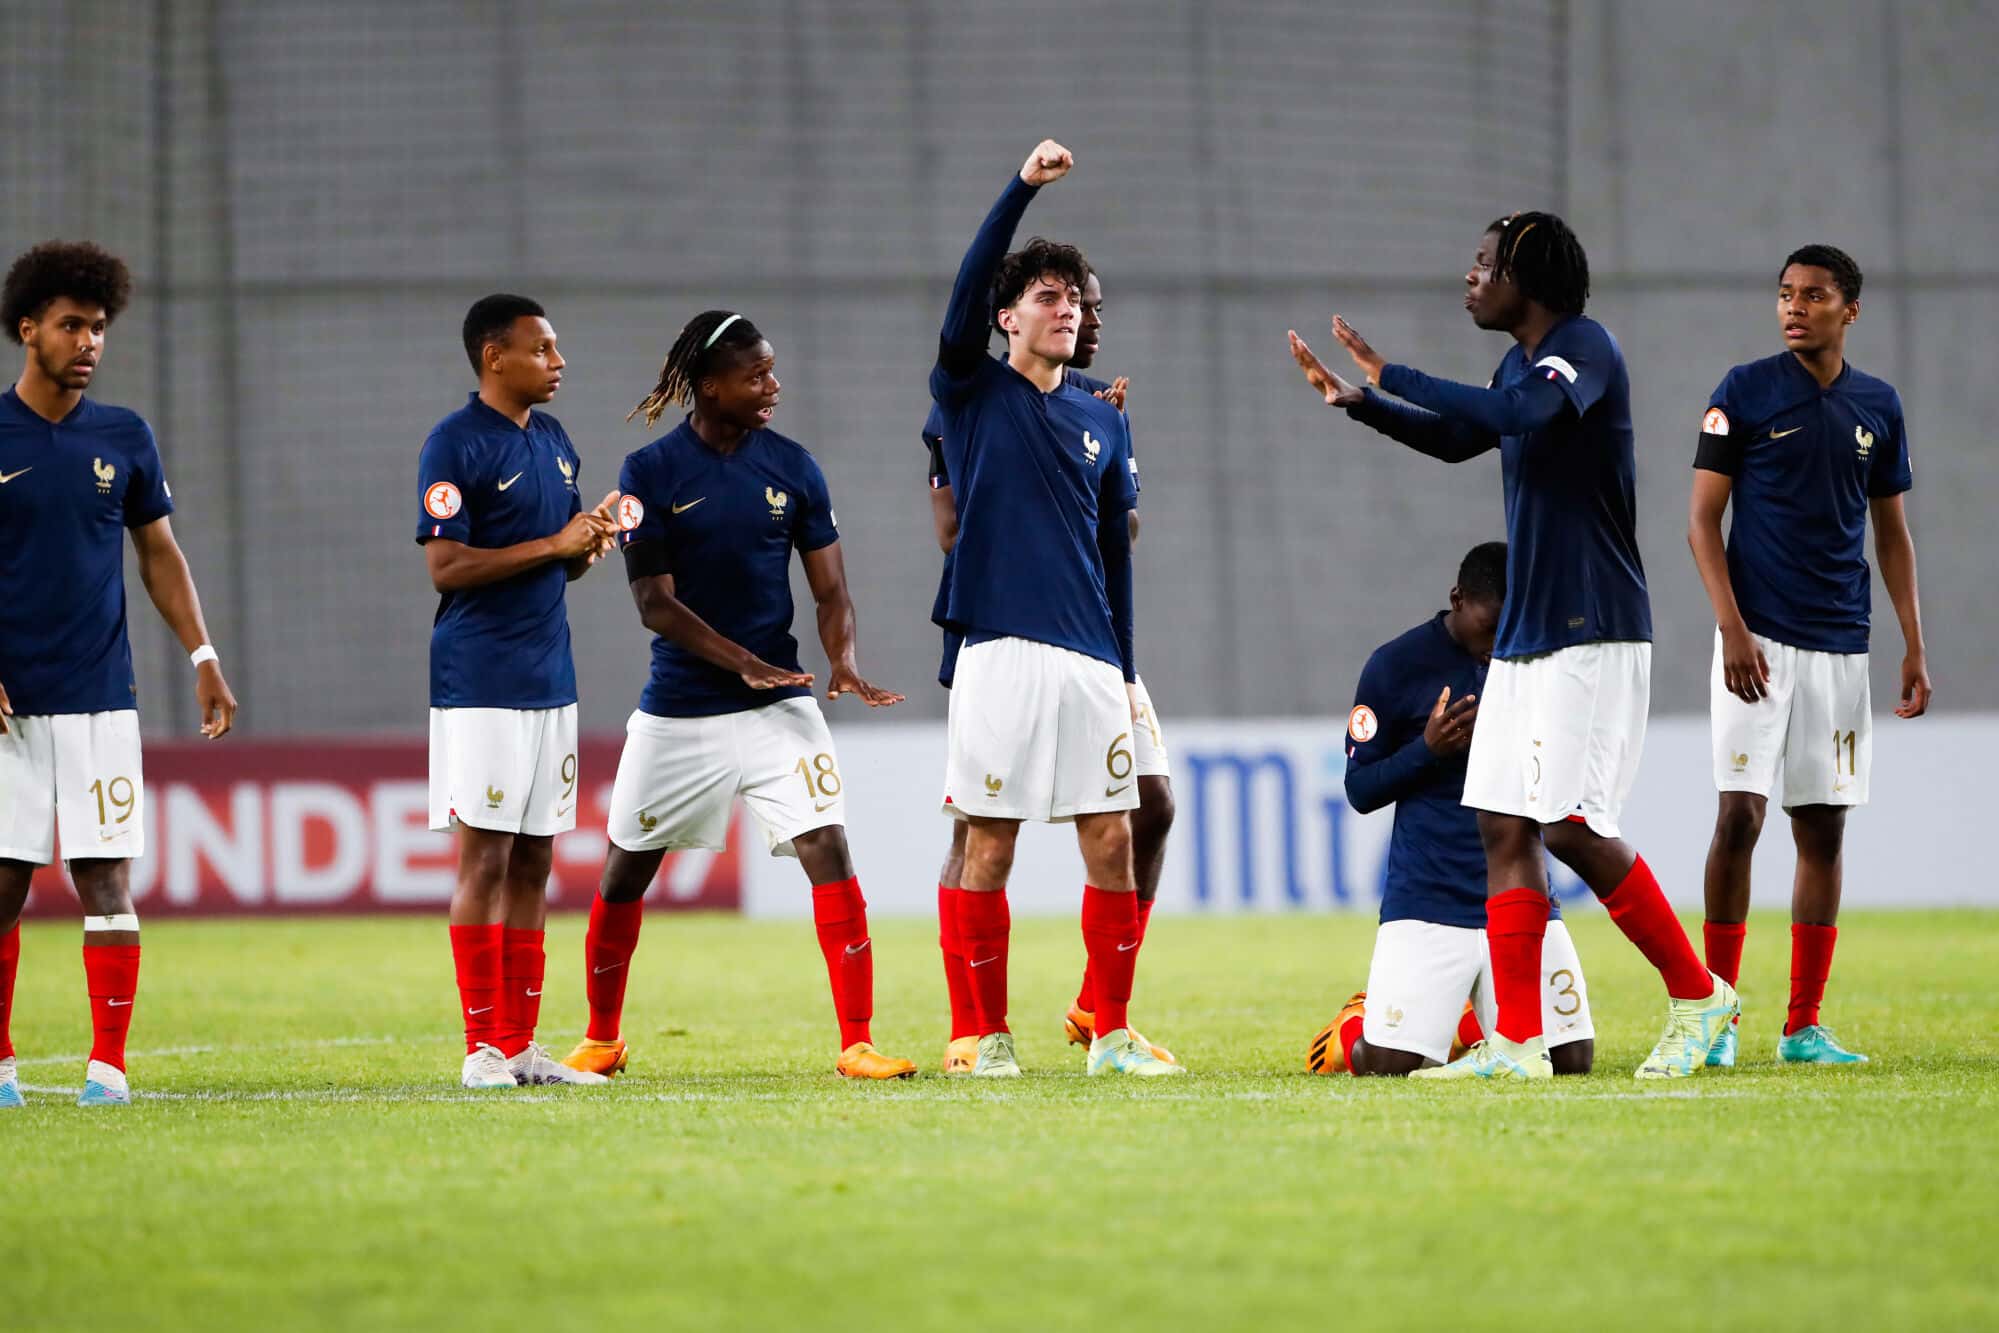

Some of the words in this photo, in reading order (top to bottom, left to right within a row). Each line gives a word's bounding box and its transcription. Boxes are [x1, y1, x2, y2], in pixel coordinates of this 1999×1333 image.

[793, 752, 841, 798] 18
[1106, 732, 1133, 780] 6
[1832, 729, 1856, 776] 11
[561, 753, 577, 800] 9
[88, 776, 135, 825] 19
[1550, 969, 1581, 1016] 3
